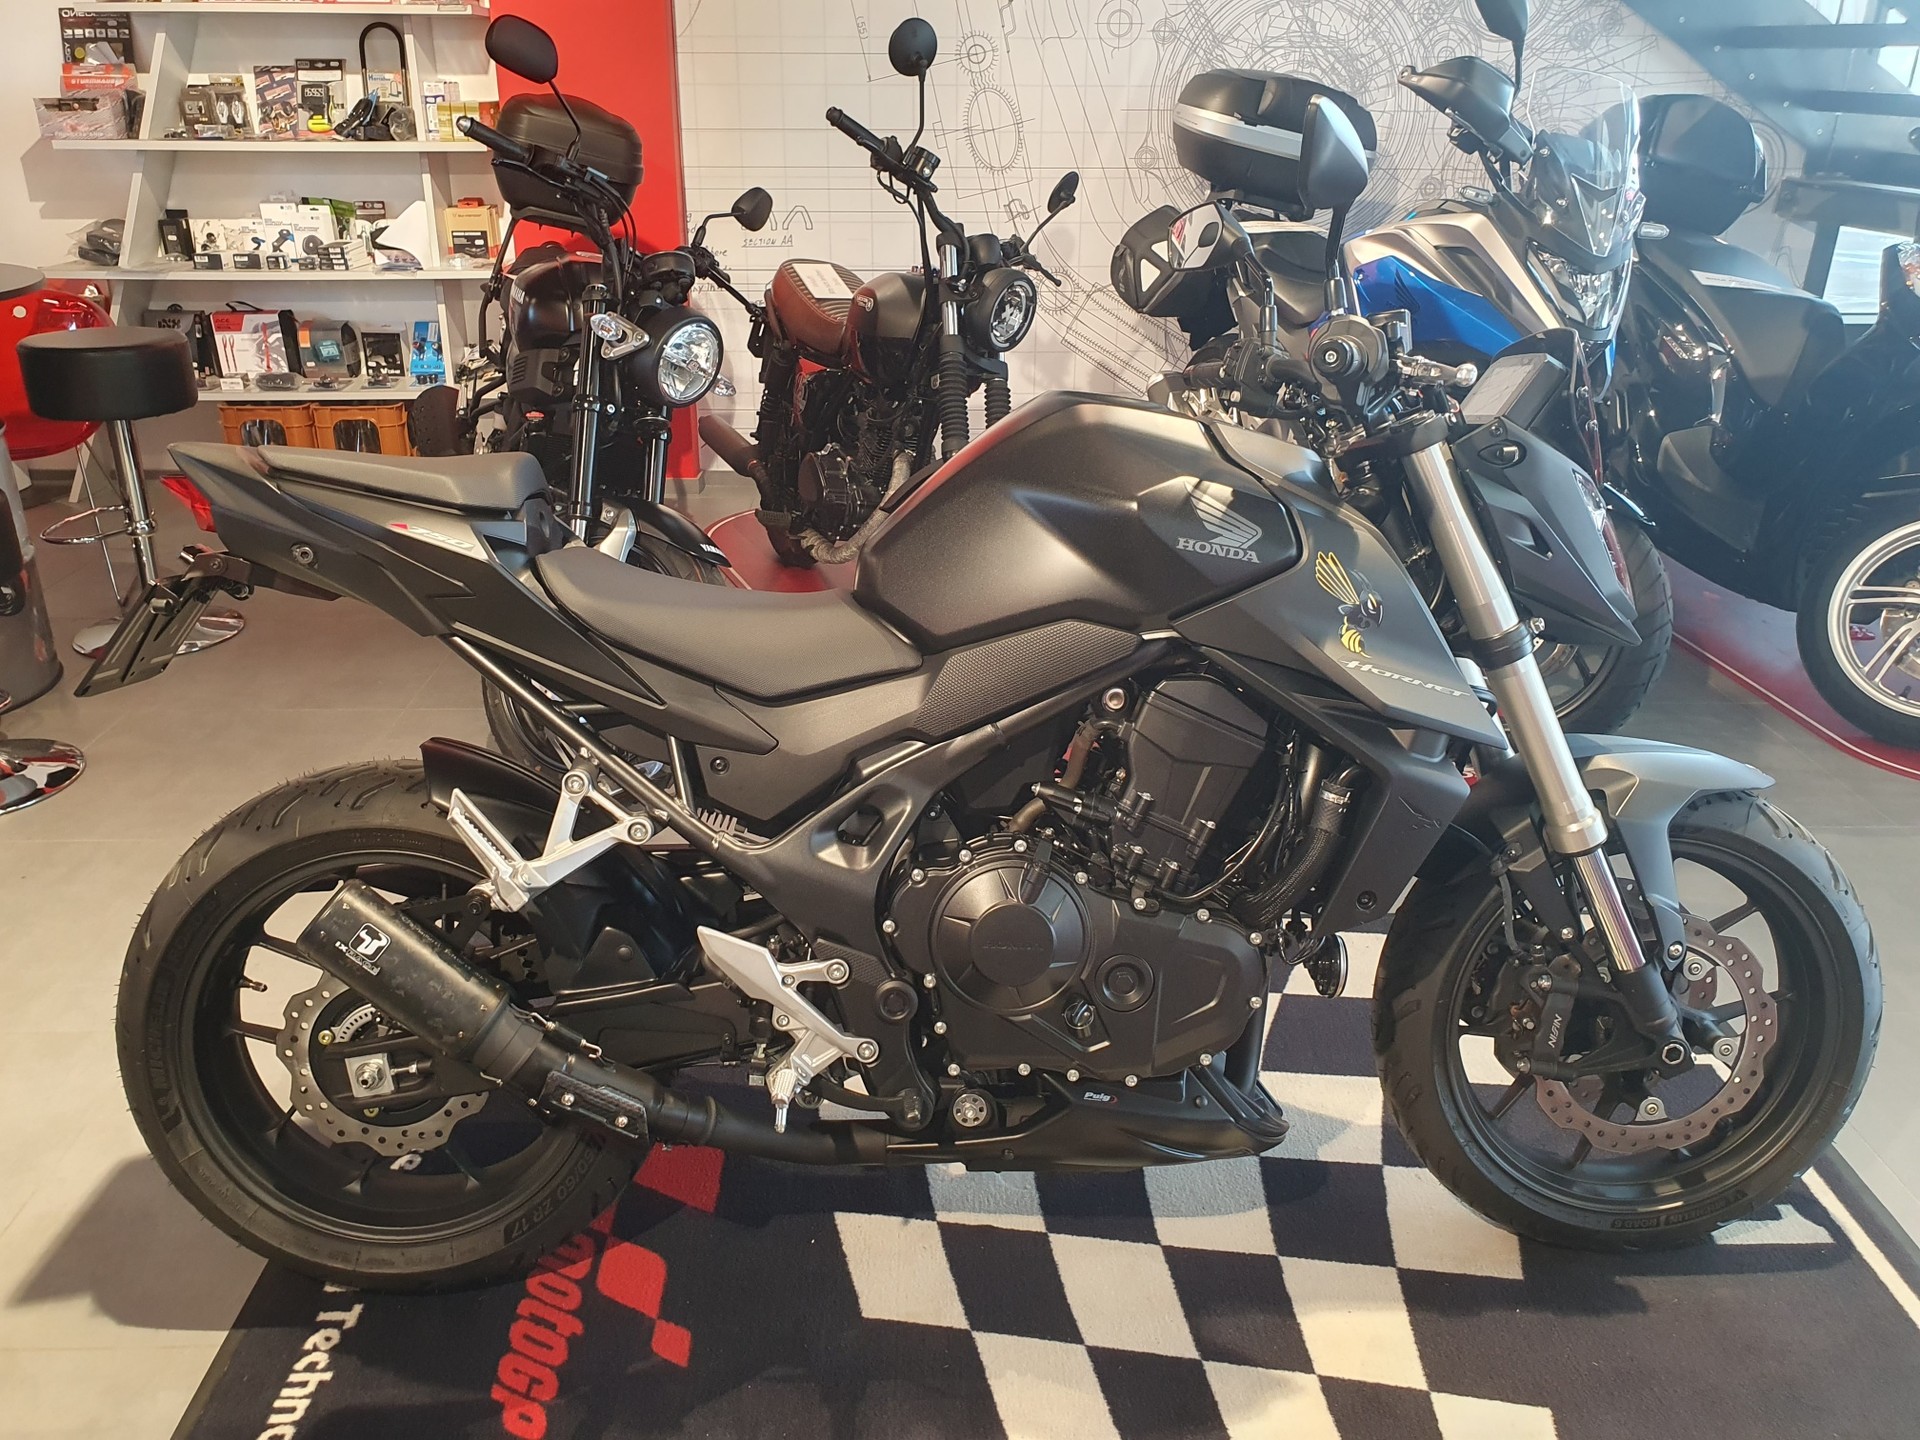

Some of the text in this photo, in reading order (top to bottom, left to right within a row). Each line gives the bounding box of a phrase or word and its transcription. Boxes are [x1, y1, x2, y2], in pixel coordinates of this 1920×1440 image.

[780, 234, 793, 246] AA
[1176, 537, 1261, 564] HONDA
[1084, 1091, 1112, 1102] Puig
